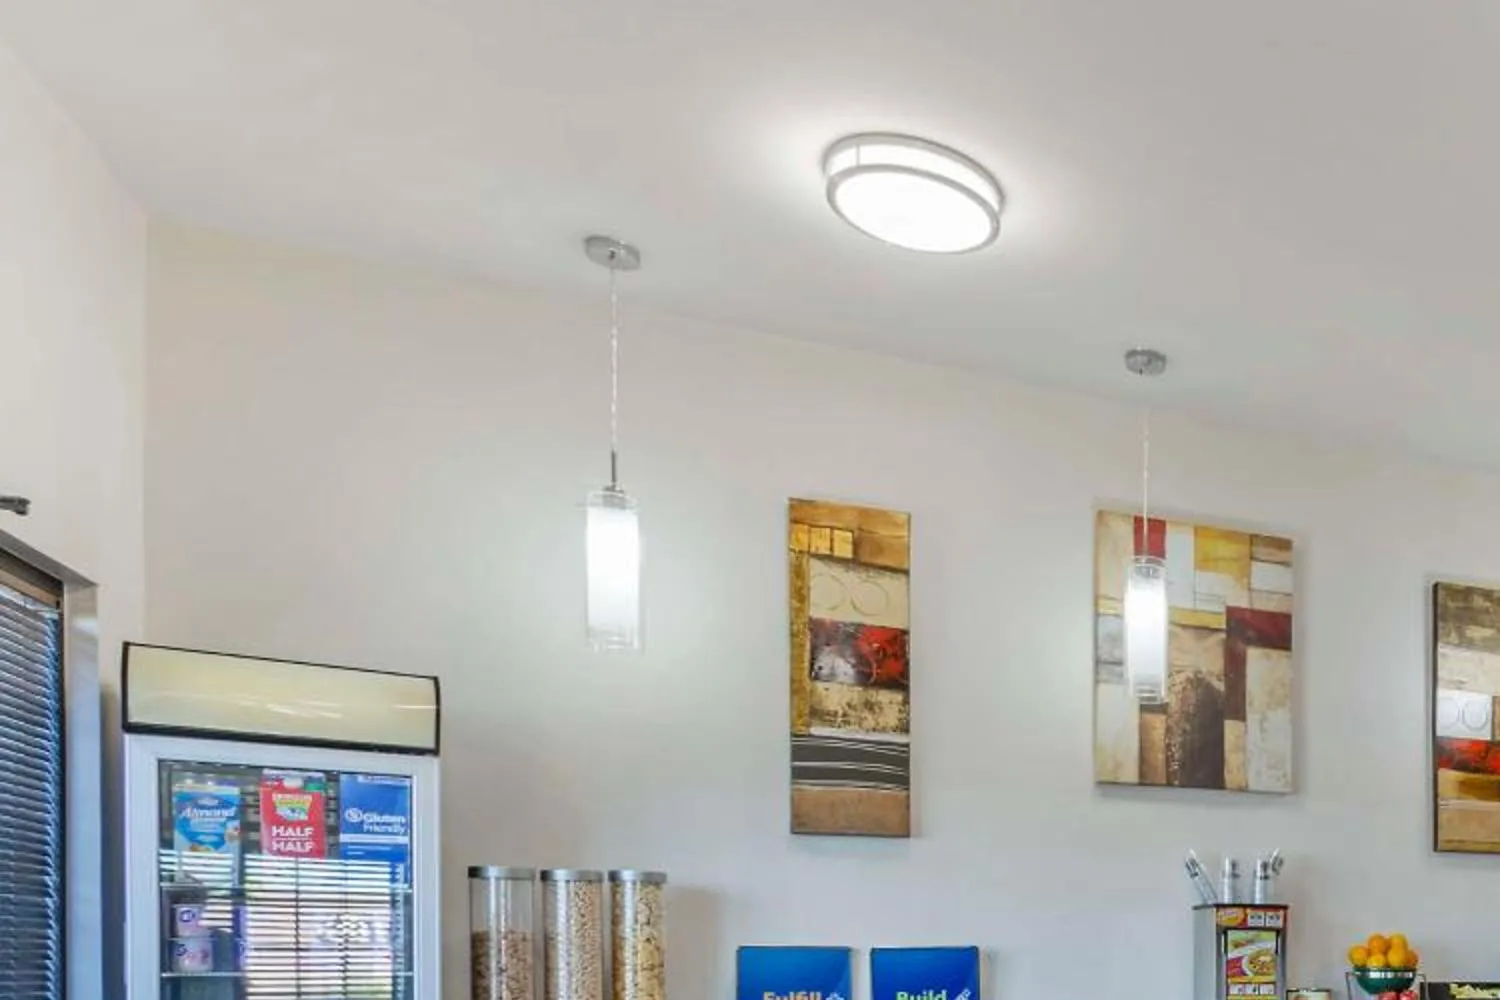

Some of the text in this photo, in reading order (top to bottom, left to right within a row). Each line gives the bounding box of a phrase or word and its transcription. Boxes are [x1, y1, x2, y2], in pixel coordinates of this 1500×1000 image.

[363, 812, 406, 824] Gluten
[271, 825, 314, 837] HALF
[271, 841, 314, 853] HALF
